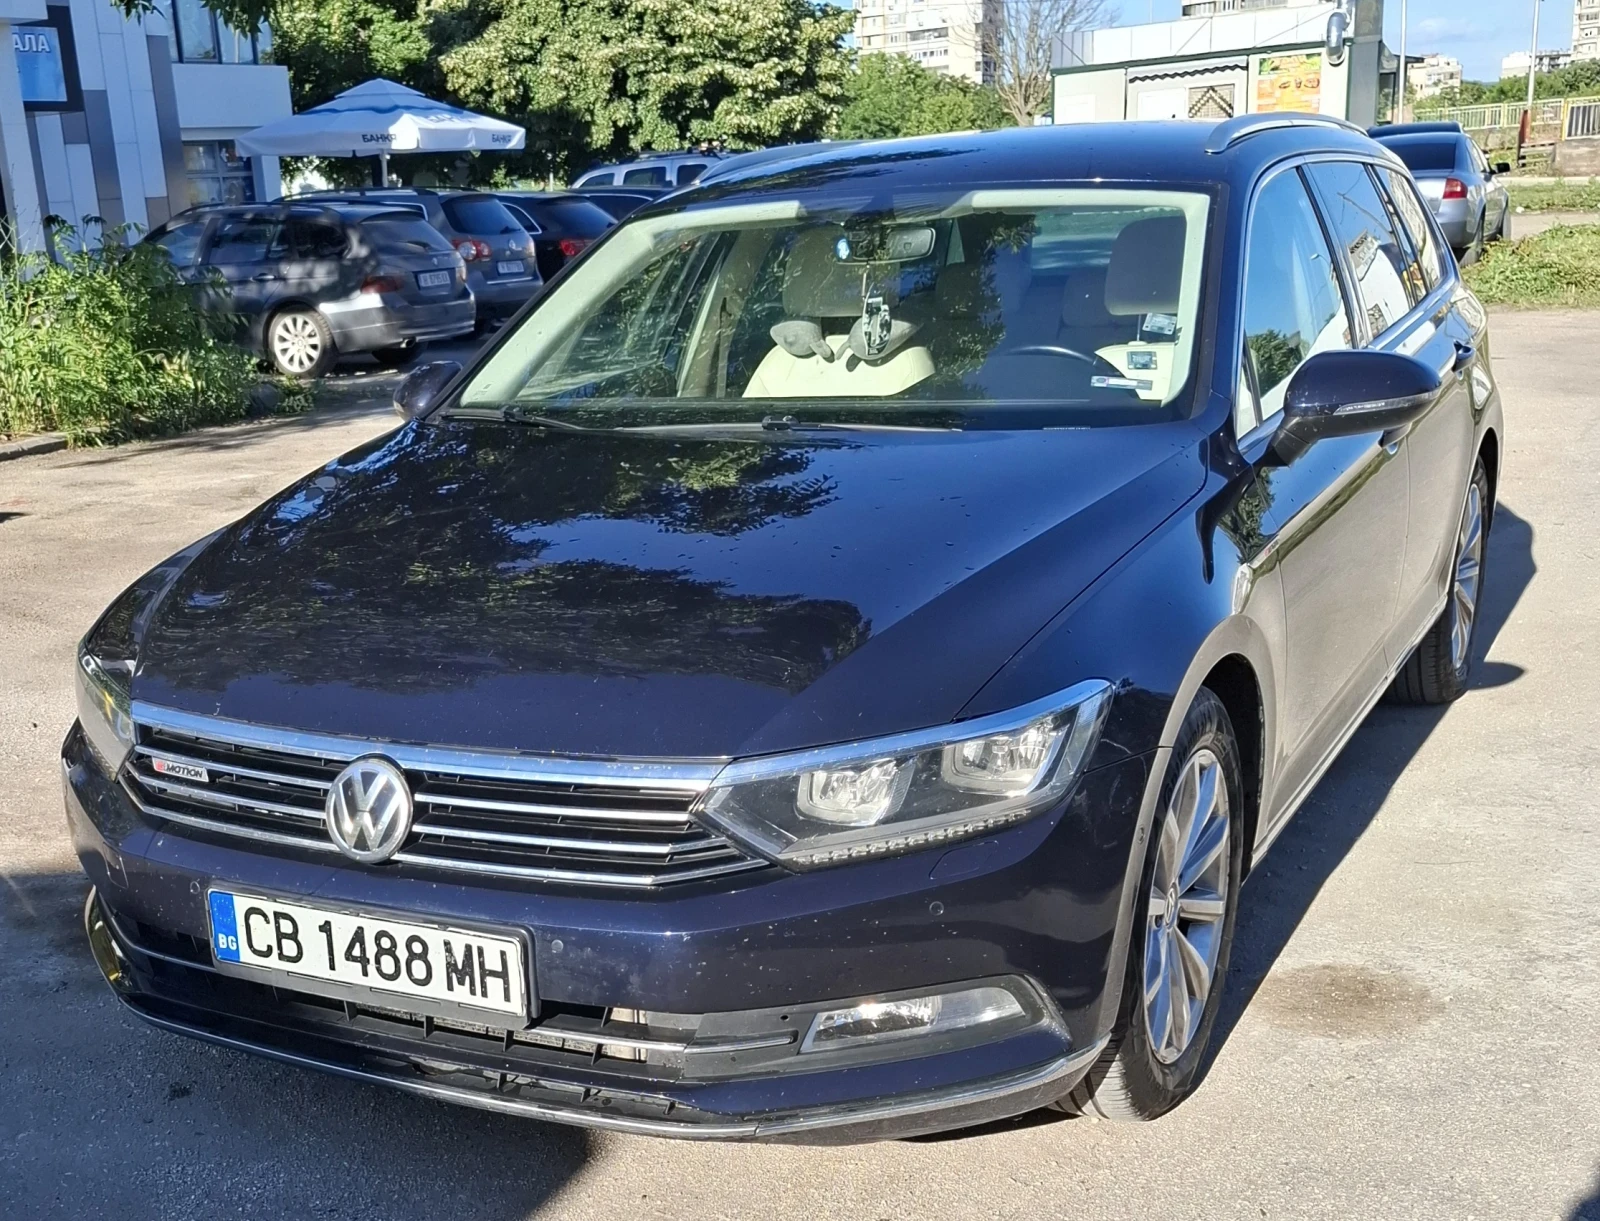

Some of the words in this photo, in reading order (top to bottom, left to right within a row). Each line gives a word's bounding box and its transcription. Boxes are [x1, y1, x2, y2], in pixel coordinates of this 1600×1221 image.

[362, 133, 397, 143] БАНКЯ
[218, 932, 238, 952] BG
[243, 906, 304, 964] CB
[318, 920, 433, 987] 1488
[443, 938, 512, 1003] MH
